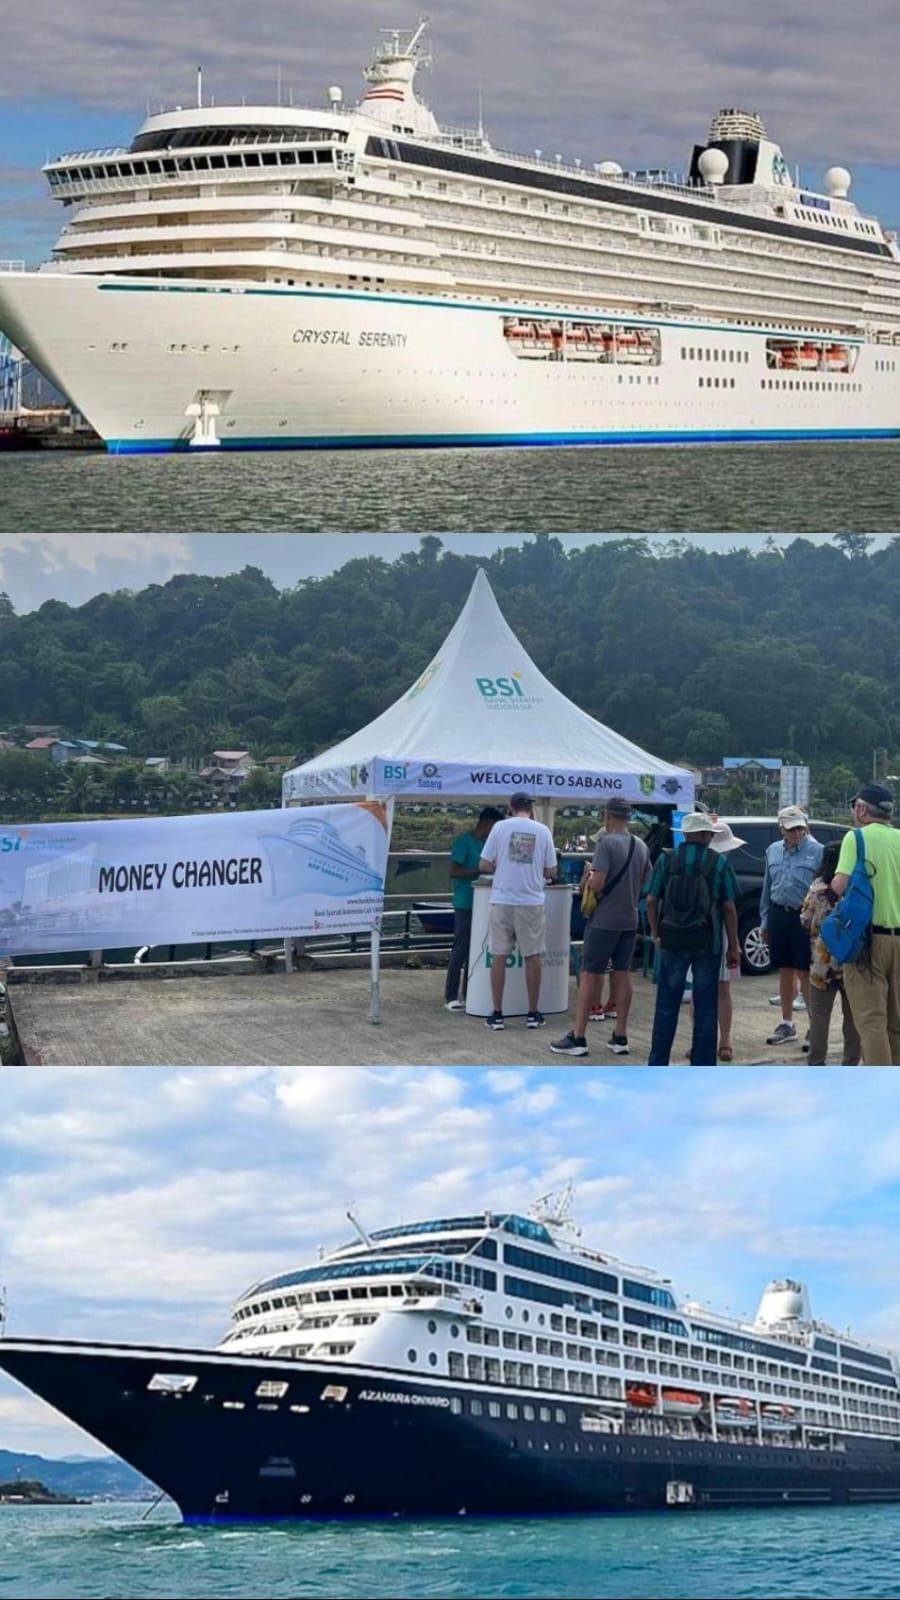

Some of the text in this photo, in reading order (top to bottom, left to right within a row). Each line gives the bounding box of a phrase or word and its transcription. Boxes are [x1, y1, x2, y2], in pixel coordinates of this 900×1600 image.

[292, 329, 408, 348] CRYSTAL SERENITY
[417, 778, 443, 791] Sabang
[470, 772, 623, 790] WELCOME TO SABANG
[98, 857, 263, 894] MONEY CHANGER
